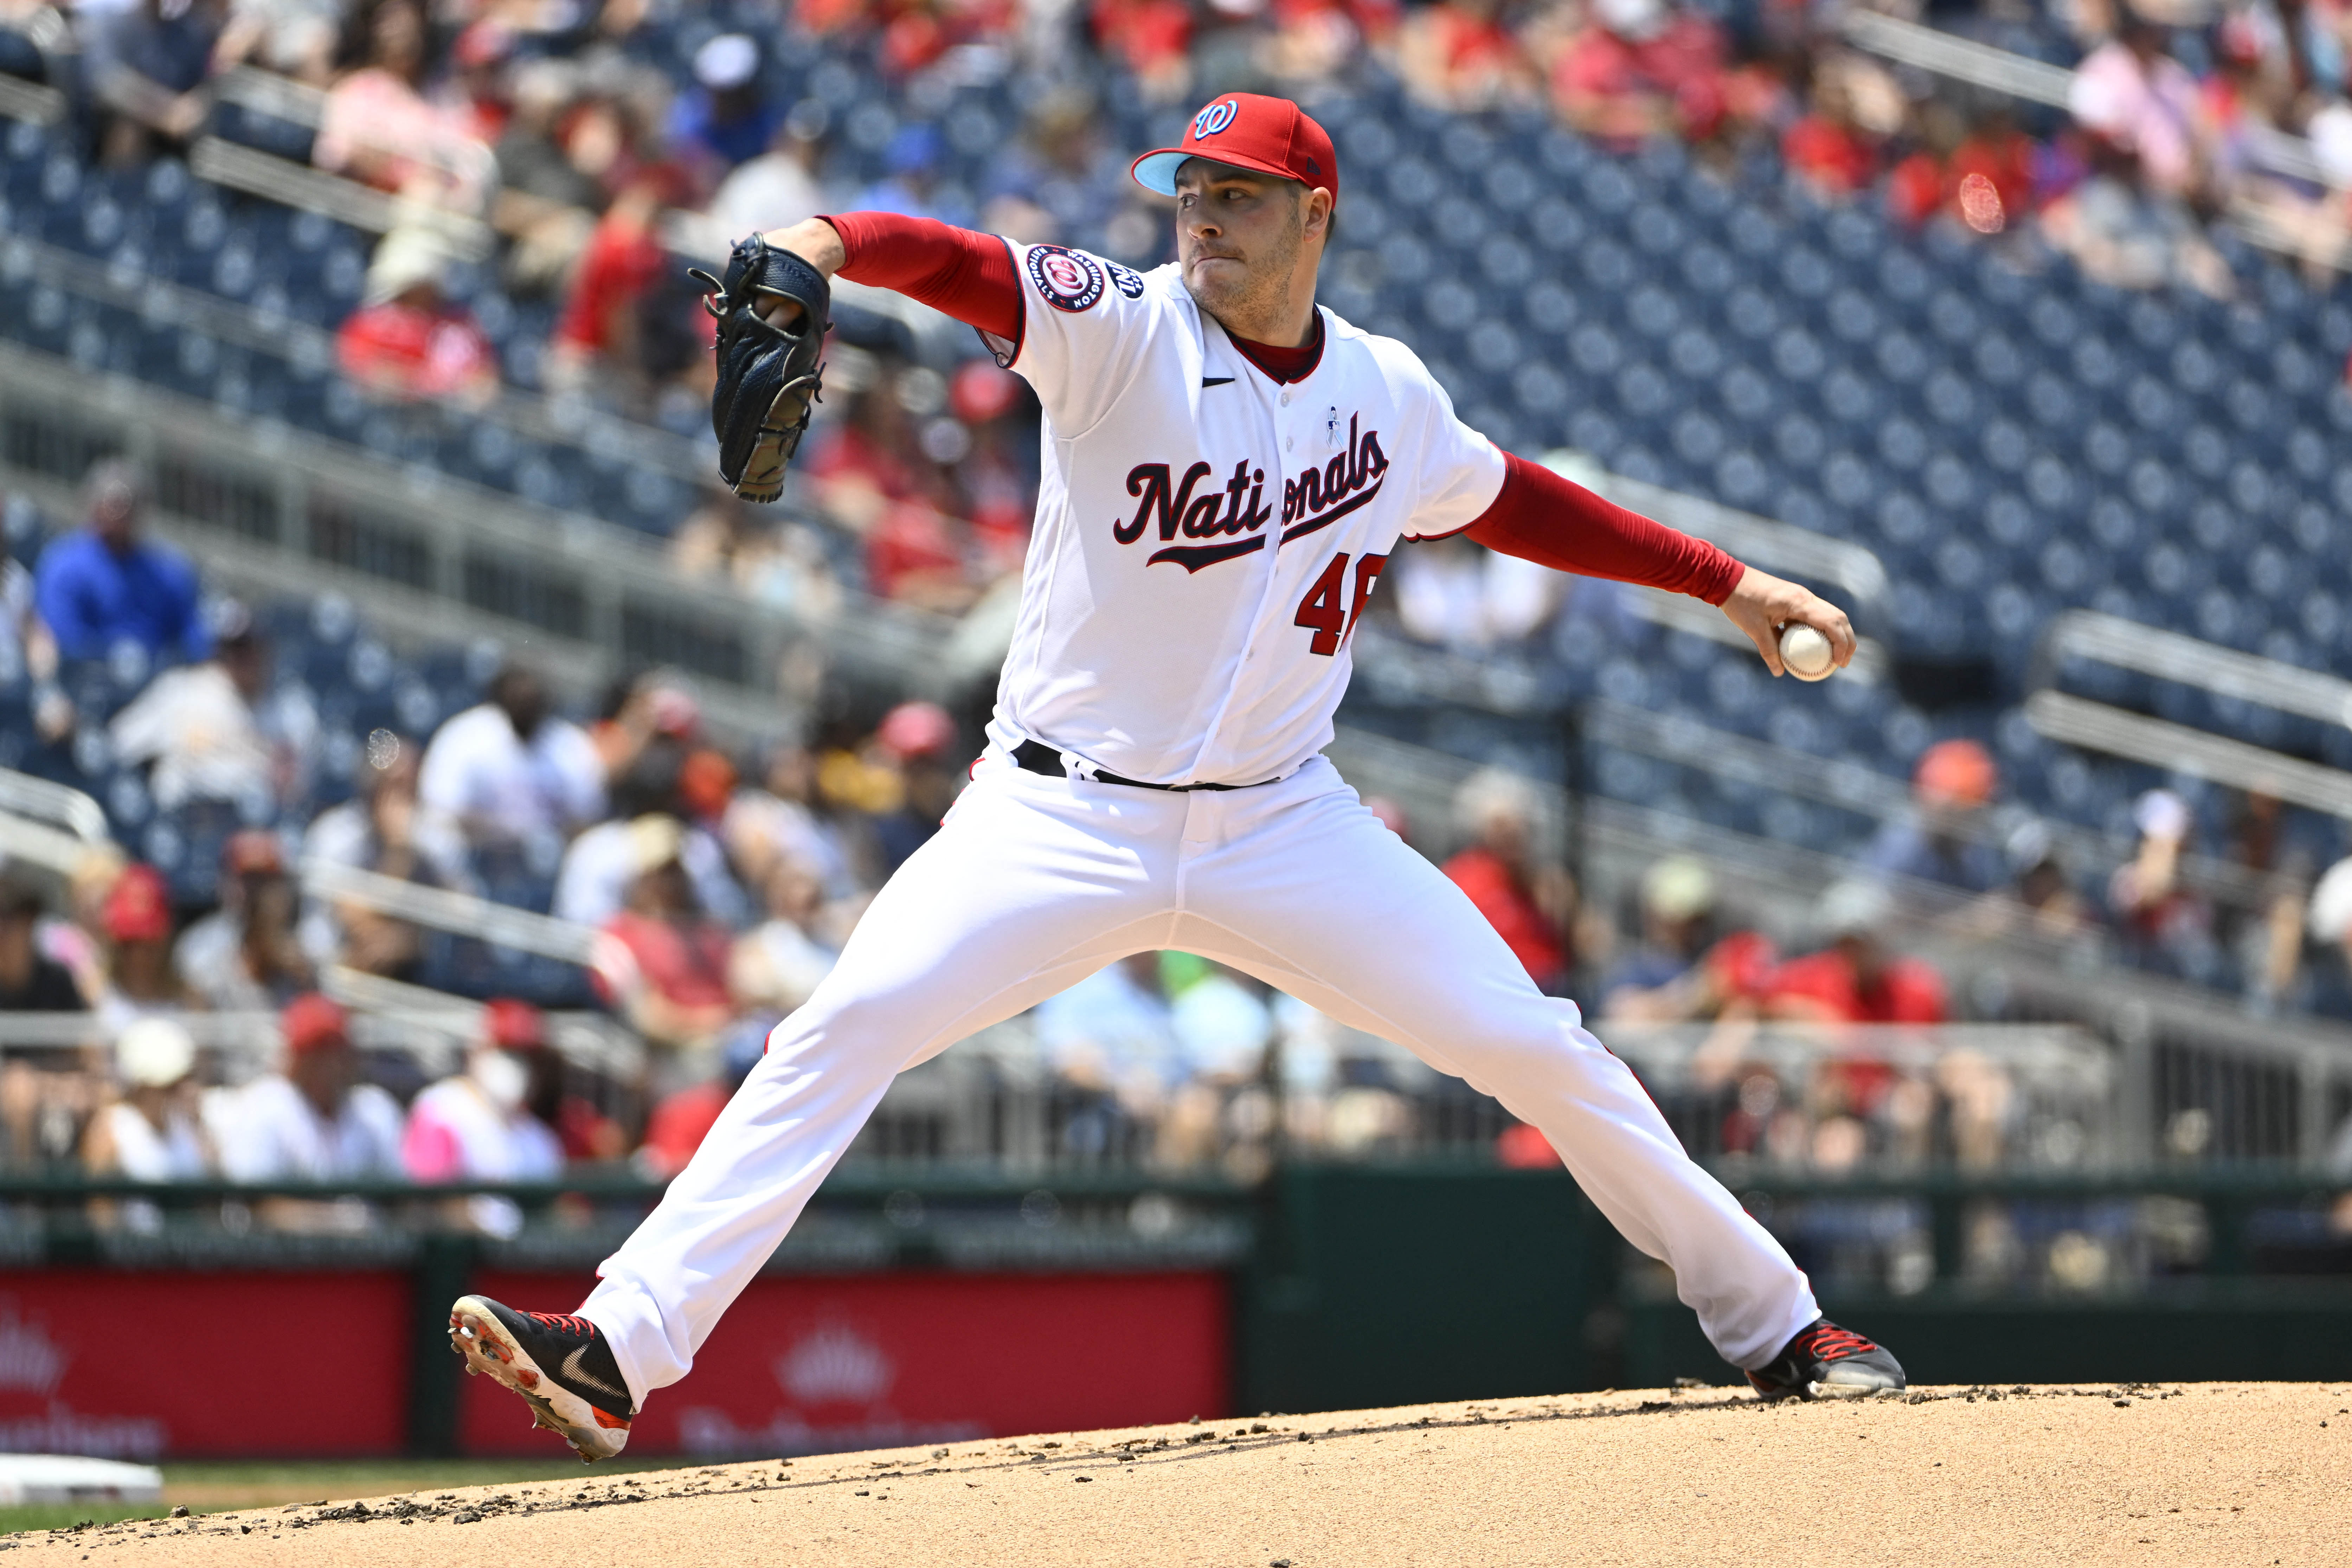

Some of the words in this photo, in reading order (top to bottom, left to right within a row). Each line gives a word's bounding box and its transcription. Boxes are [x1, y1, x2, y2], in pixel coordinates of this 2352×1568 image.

[1194, 100, 1238, 141] W
[1029, 247, 1054, 299] NATIONALS
[1067, 251, 1102, 308] WASHINGTON
[1113, 410, 1389, 545] Nationals
